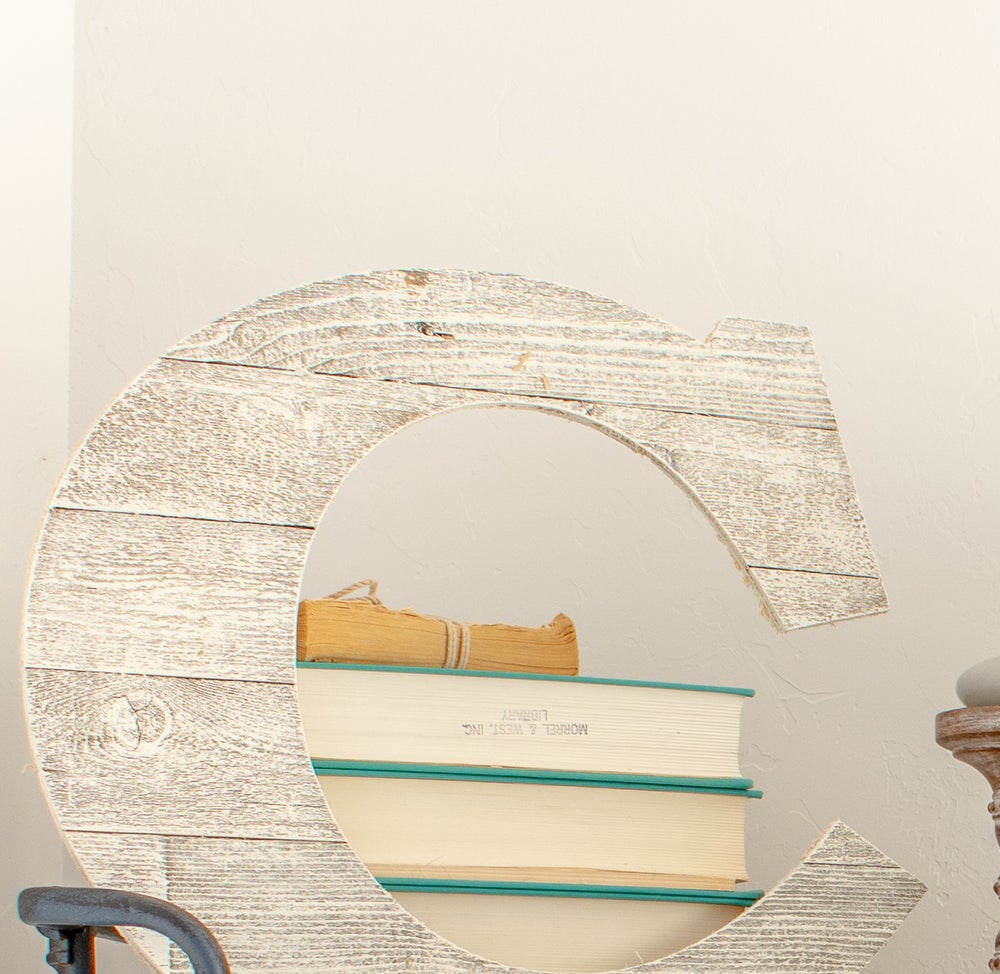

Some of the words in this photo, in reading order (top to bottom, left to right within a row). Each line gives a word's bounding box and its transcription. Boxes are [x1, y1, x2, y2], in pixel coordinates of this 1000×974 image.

[501, 709, 548, 721] LIBRARY
[529, 724, 537, 735] &
[543, 724, 588, 736] MORREL
